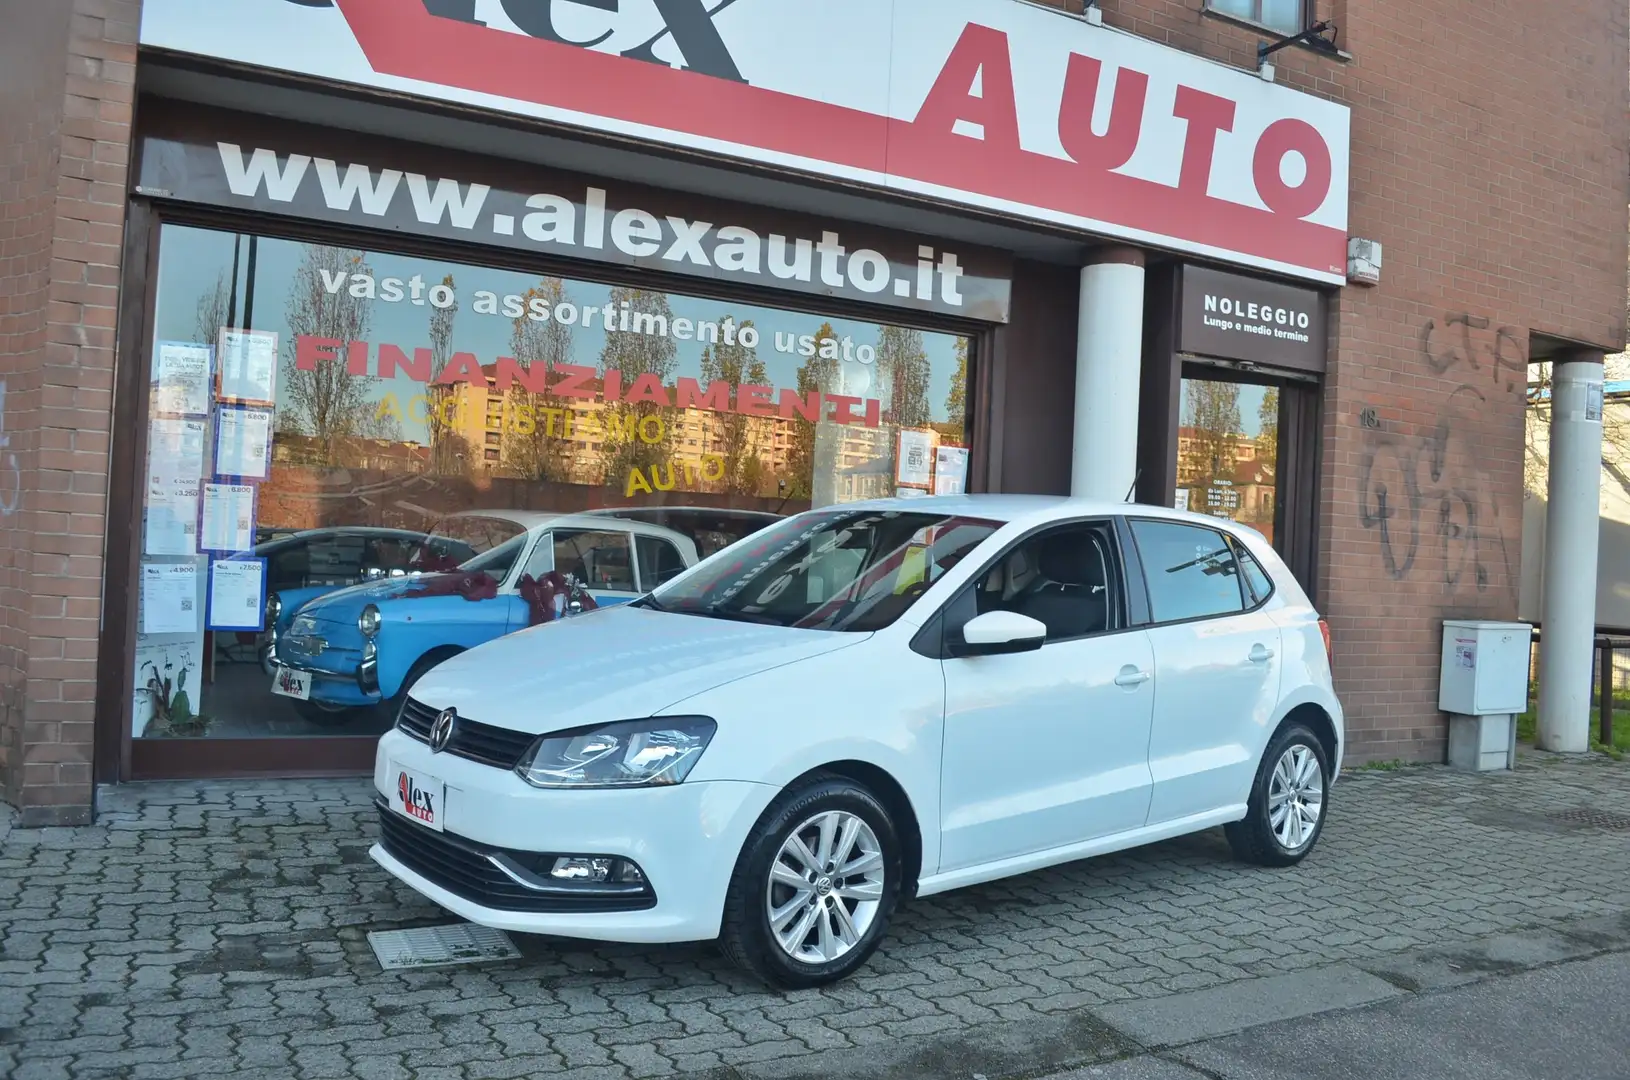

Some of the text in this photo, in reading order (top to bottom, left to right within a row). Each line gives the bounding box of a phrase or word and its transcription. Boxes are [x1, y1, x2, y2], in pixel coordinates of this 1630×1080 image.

[911, 22, 1332, 220] AUTO
[217, 142, 964, 307] www.alexauto.it
[319, 268, 877, 365] vasto assortimento usato
[1203, 314, 1309, 343] Lungo e medio termine
[1204, 294, 1309, 329] NOLEGGIO
[295, 334, 880, 428] FINANZIAMENTI
[374, 391, 666, 445] ACQUISTIAMO
[624, 453, 726, 498] AUTO
[397, 771, 435, 814] Alex
